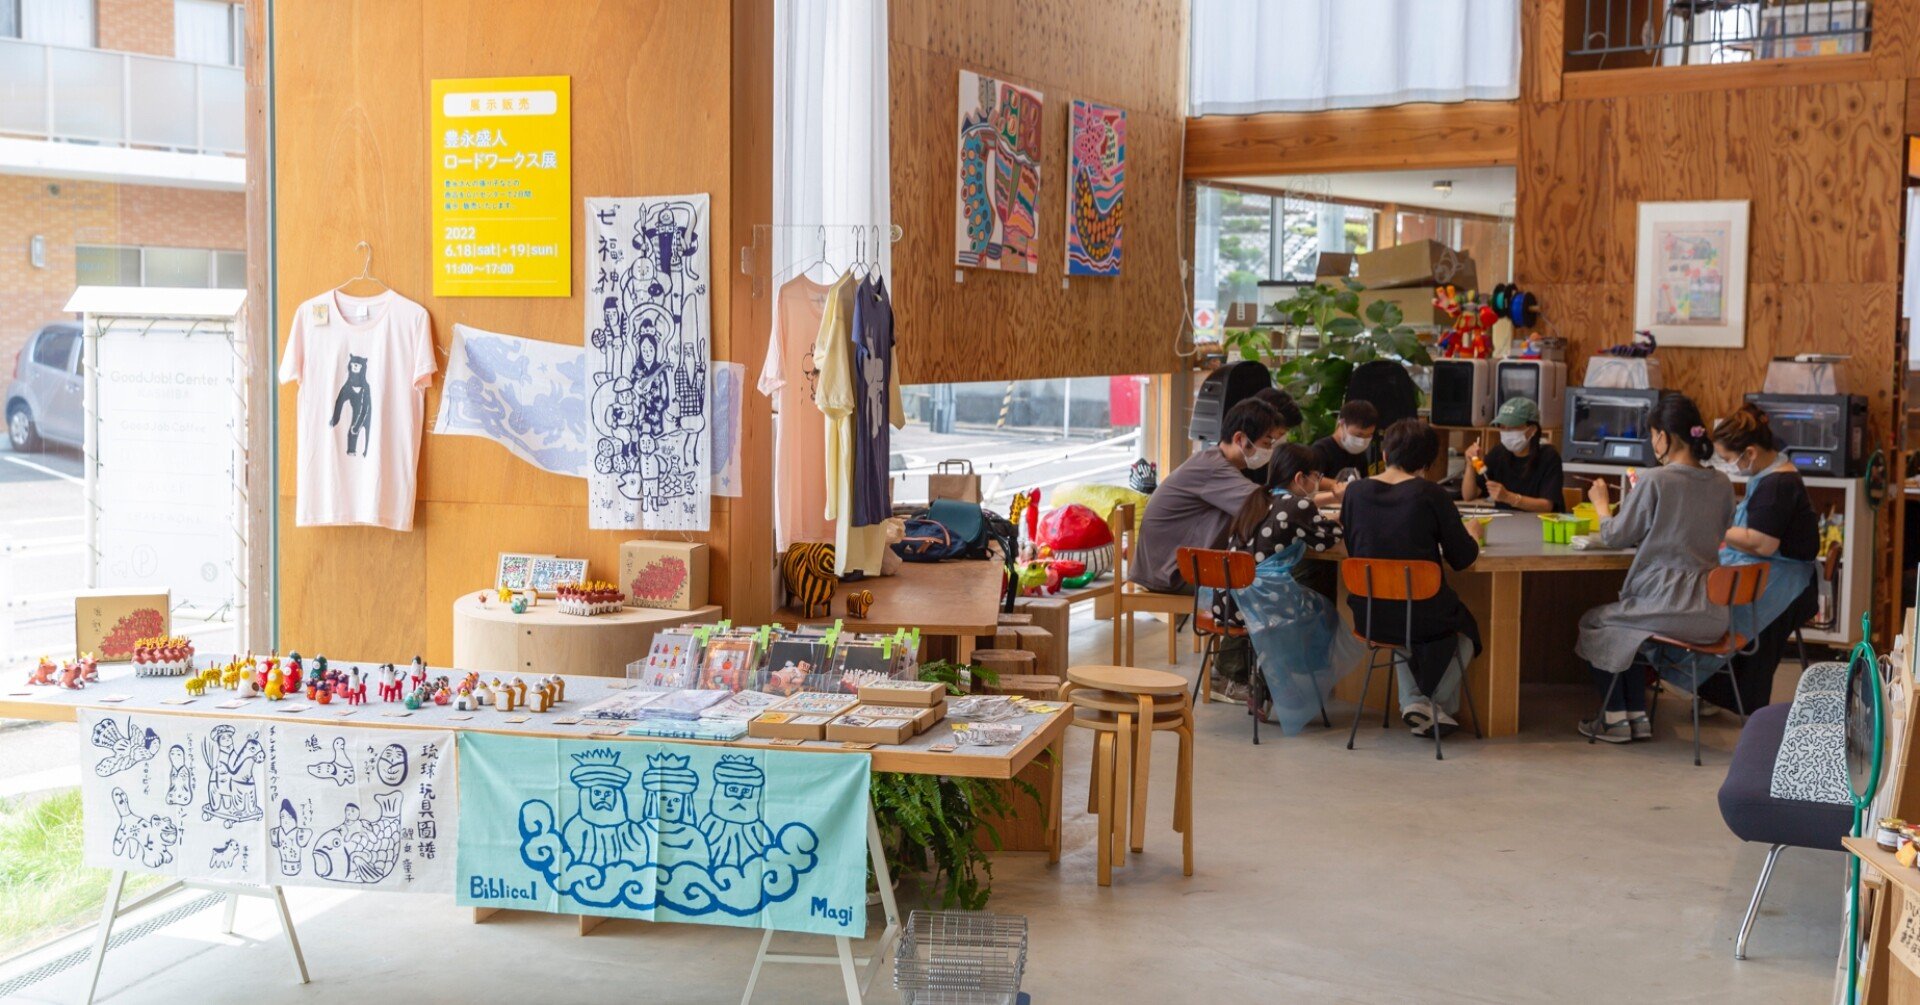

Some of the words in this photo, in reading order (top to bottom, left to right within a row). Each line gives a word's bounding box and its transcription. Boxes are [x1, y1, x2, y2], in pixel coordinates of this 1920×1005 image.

[470, 97, 530, 112] 展示販売
[444, 129, 507, 148] 豊永盛人
[444, 152, 557, 170] ロードワークス展
[445, 226, 476, 240] 2022
[597, 209, 619, 292] 七福神
[175, 372, 218, 386] Center
[305, 734, 322, 752] 鳩
[470, 875, 537, 901] Biblical
[811, 896, 853, 927] Magi
